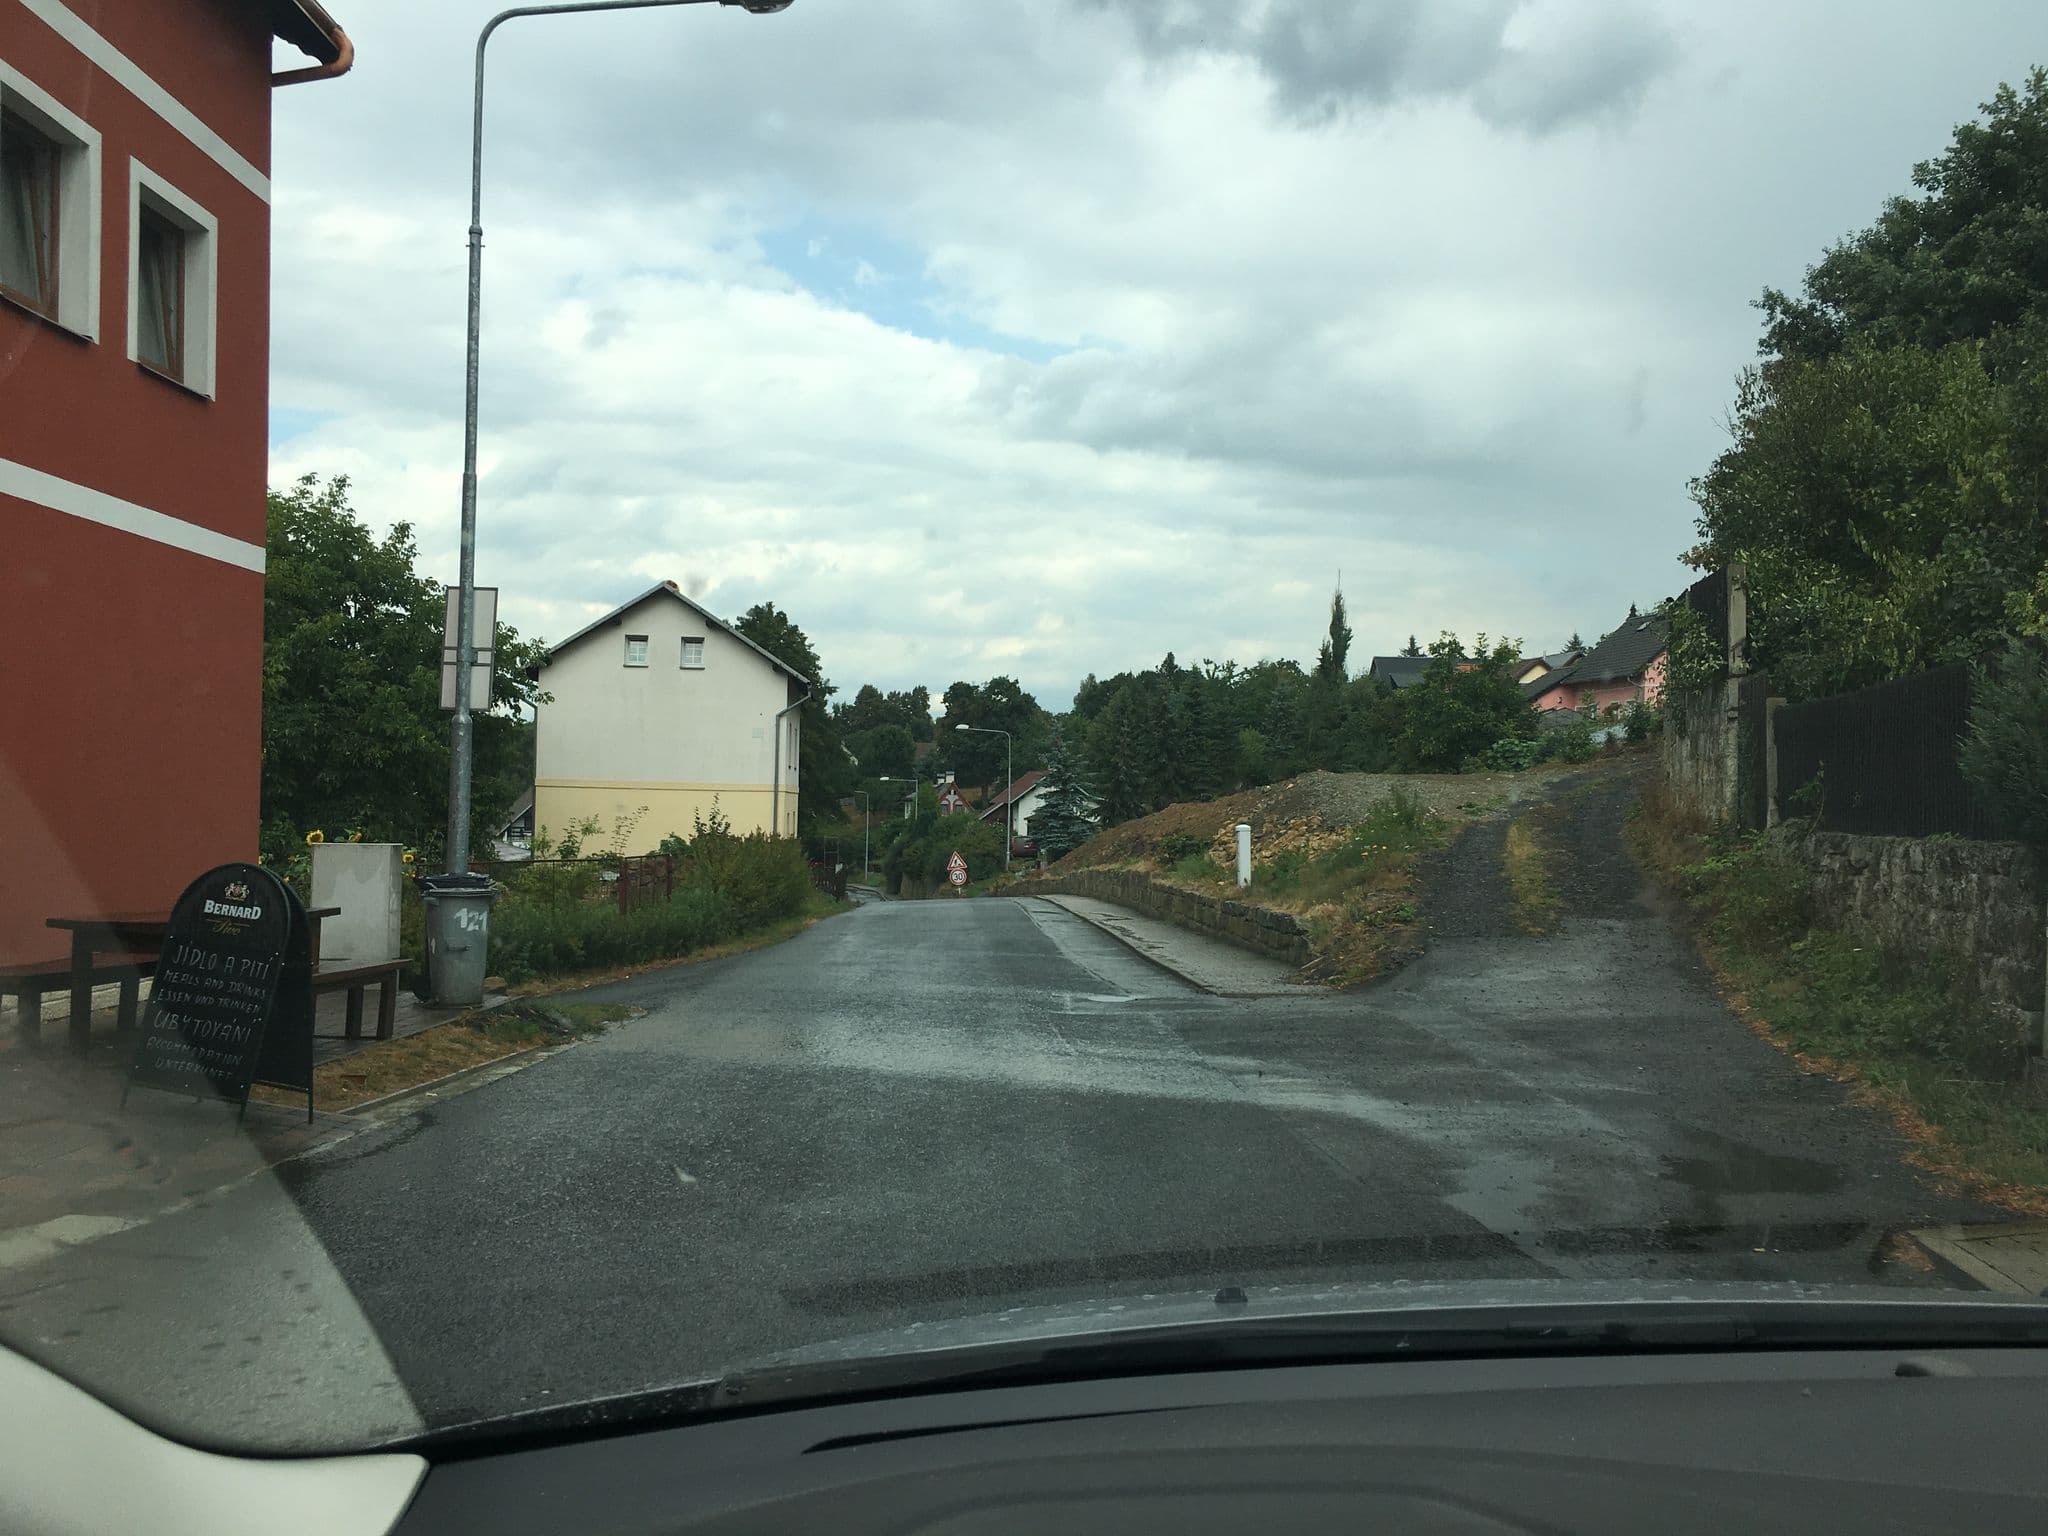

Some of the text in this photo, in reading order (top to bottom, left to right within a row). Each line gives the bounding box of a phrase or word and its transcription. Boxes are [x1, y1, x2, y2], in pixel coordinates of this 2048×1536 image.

[954, 873, 963, 881] 30
[203, 899, 262, 920] BERNARD
[454, 907, 488, 934] 121
[172, 940, 274, 980] JÍDLO A PITÍ
[163, 969, 267, 998] MEALS AND DRINKS
[157, 990, 262, 1014] ESSEN UND TRINKEN
